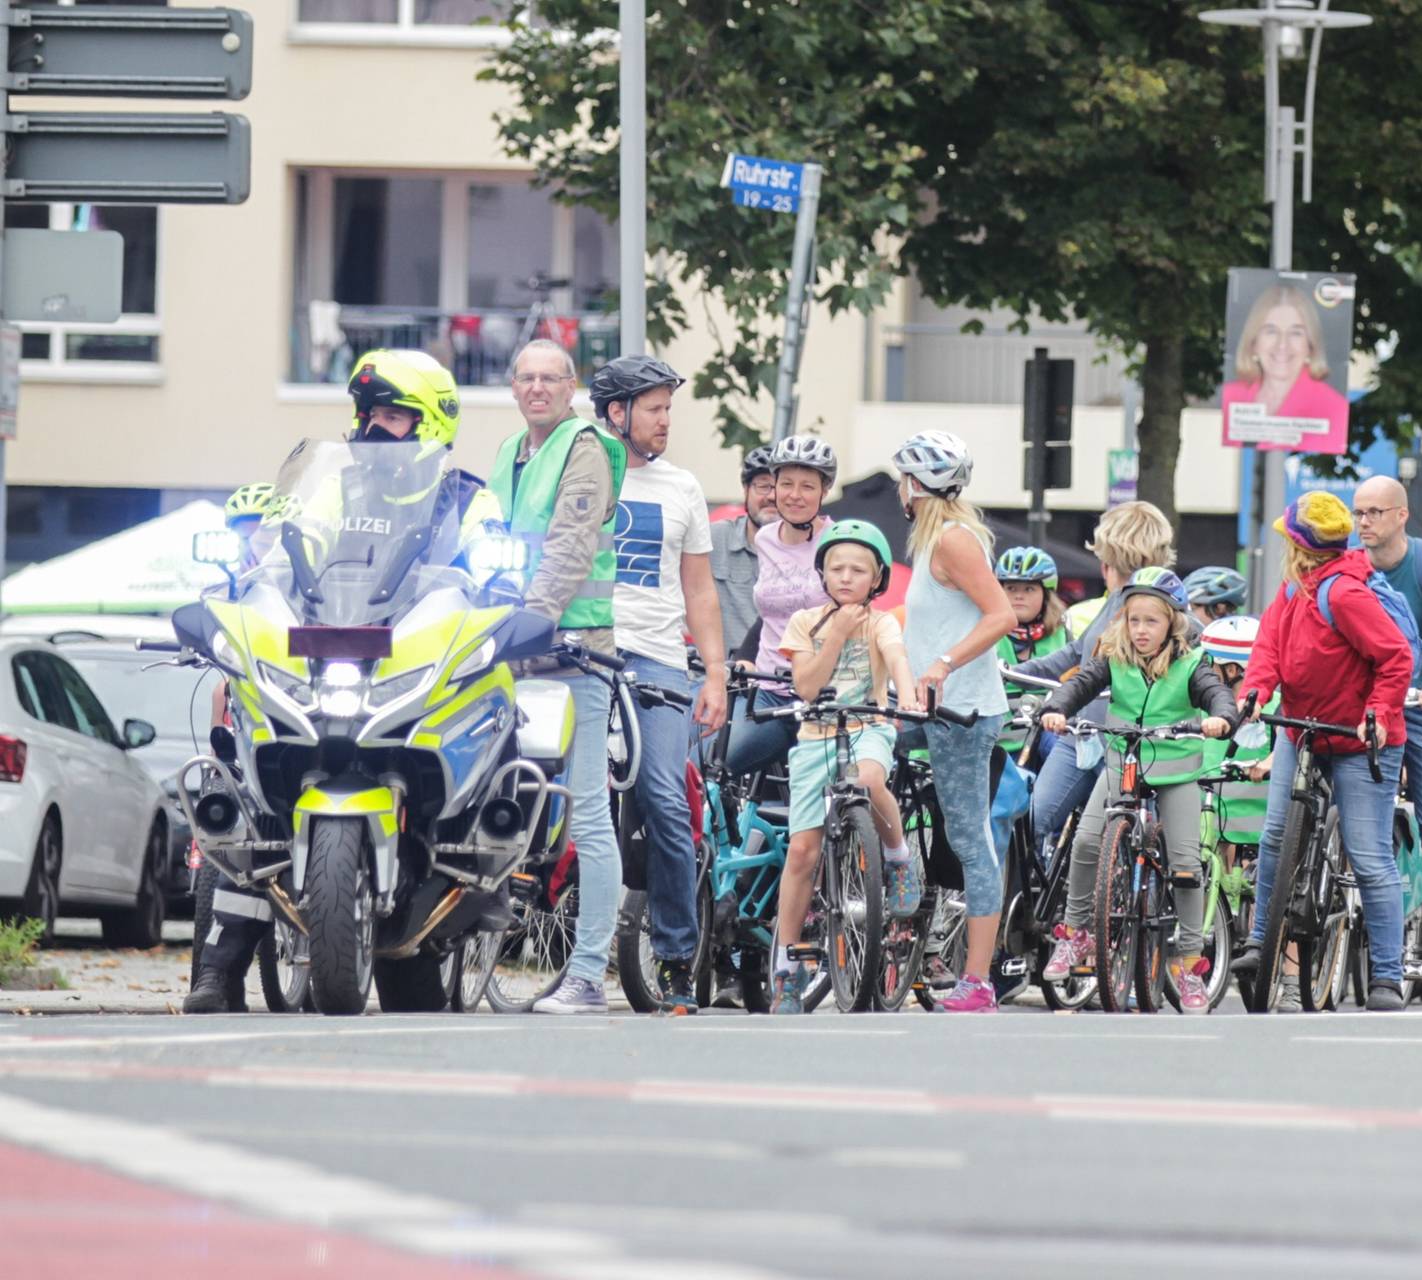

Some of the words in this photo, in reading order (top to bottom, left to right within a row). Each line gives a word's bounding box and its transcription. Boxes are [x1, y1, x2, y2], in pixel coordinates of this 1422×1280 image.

[733, 159, 799, 192] Ruhrstr.
[743, 190, 761, 208] 19
[771, 194, 793, 213] 25
